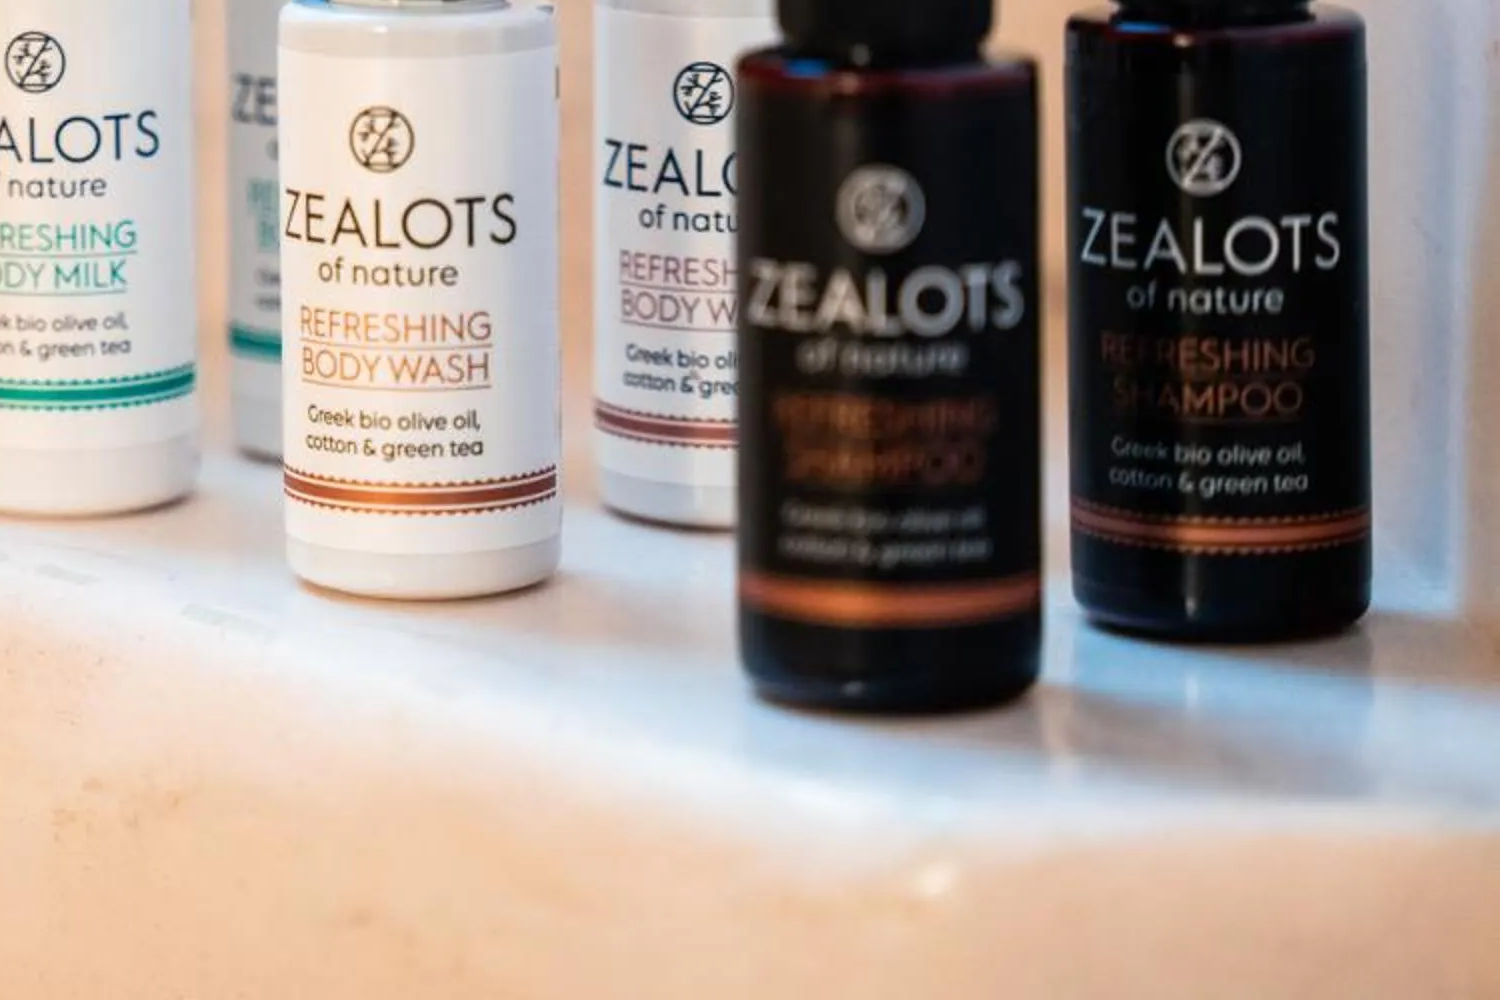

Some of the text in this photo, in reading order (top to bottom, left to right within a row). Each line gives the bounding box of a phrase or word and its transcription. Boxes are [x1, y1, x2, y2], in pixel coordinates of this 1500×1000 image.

[603, 138, 737, 197] ZEAL
[8, 177, 107, 198] nature
[285, 188, 517, 249] ZEALOTS
[638, 203, 738, 233] of natu
[1080, 207, 1341, 276] ZEALOTS
[54, 259, 127, 289] MILK
[318, 256, 459, 287] of nature
[619, 249, 739, 286] REFRESH
[621, 288, 700, 324] BODY
[746, 257, 1025, 338] ZEALOTS
[1126, 280, 1284, 315] of nature
[15, 314, 47, 331] bio
[52, 314, 97, 331] olive
[300, 305, 492, 343] REFRESHING
[19, 340, 32, 357] &
[37, 343, 96, 362] green
[100, 340, 132, 355] tea
[302, 346, 489, 384] BODY WASH
[626, 343, 738, 370] Greek bio oli
[1101, 331, 1315, 371] REFRESHING
[623, 370, 676, 393] cotton
[680, 375, 694, 393] &
[1113, 375, 1303, 416] SHAMPOO
[307, 403, 481, 432] Greek bio olive oil,
[305, 433, 484, 462] cotton & green tea
[1111, 435, 1167, 459] Greek
[1174, 443, 1211, 464] bio
[1217, 443, 1272, 465] olive
[1109, 466, 1309, 498] cotton & green tea
